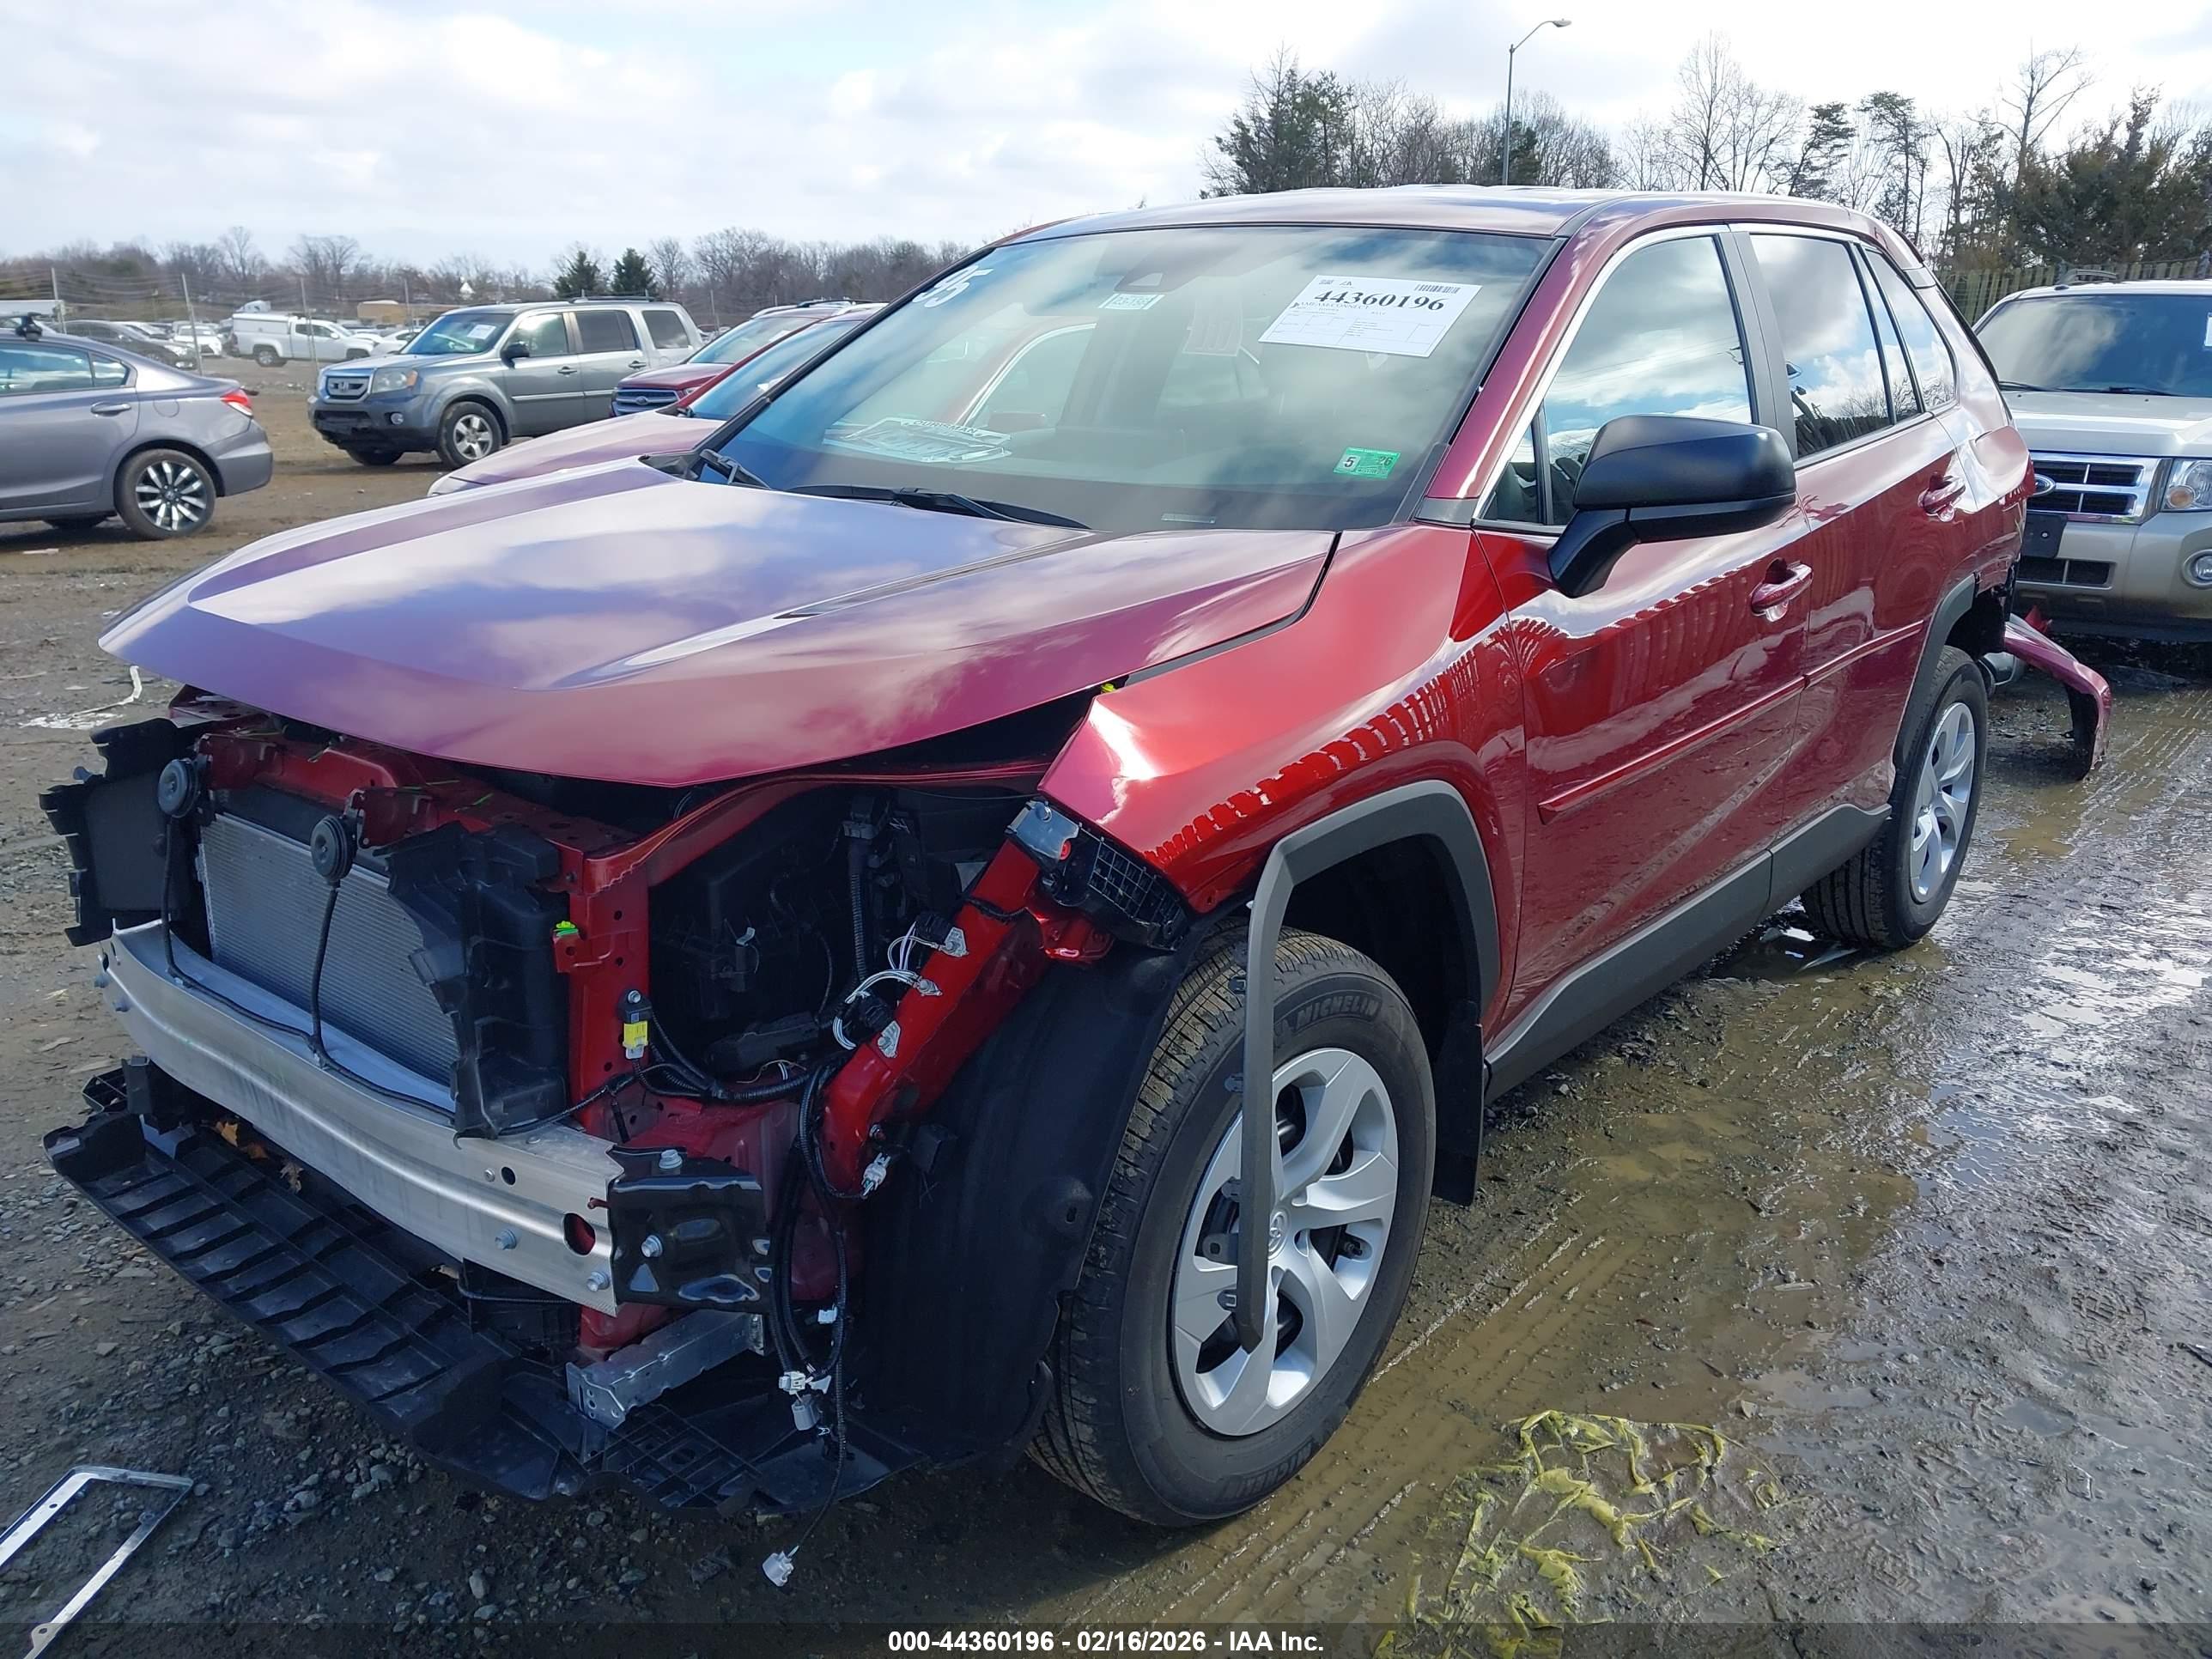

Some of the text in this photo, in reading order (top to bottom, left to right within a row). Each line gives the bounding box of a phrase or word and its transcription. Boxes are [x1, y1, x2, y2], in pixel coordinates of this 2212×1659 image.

[1315, 290, 1449, 311] 44360196
[1344, 456, 1357, 468] 5
[1296, 994, 1381, 1029] MICHELIN
